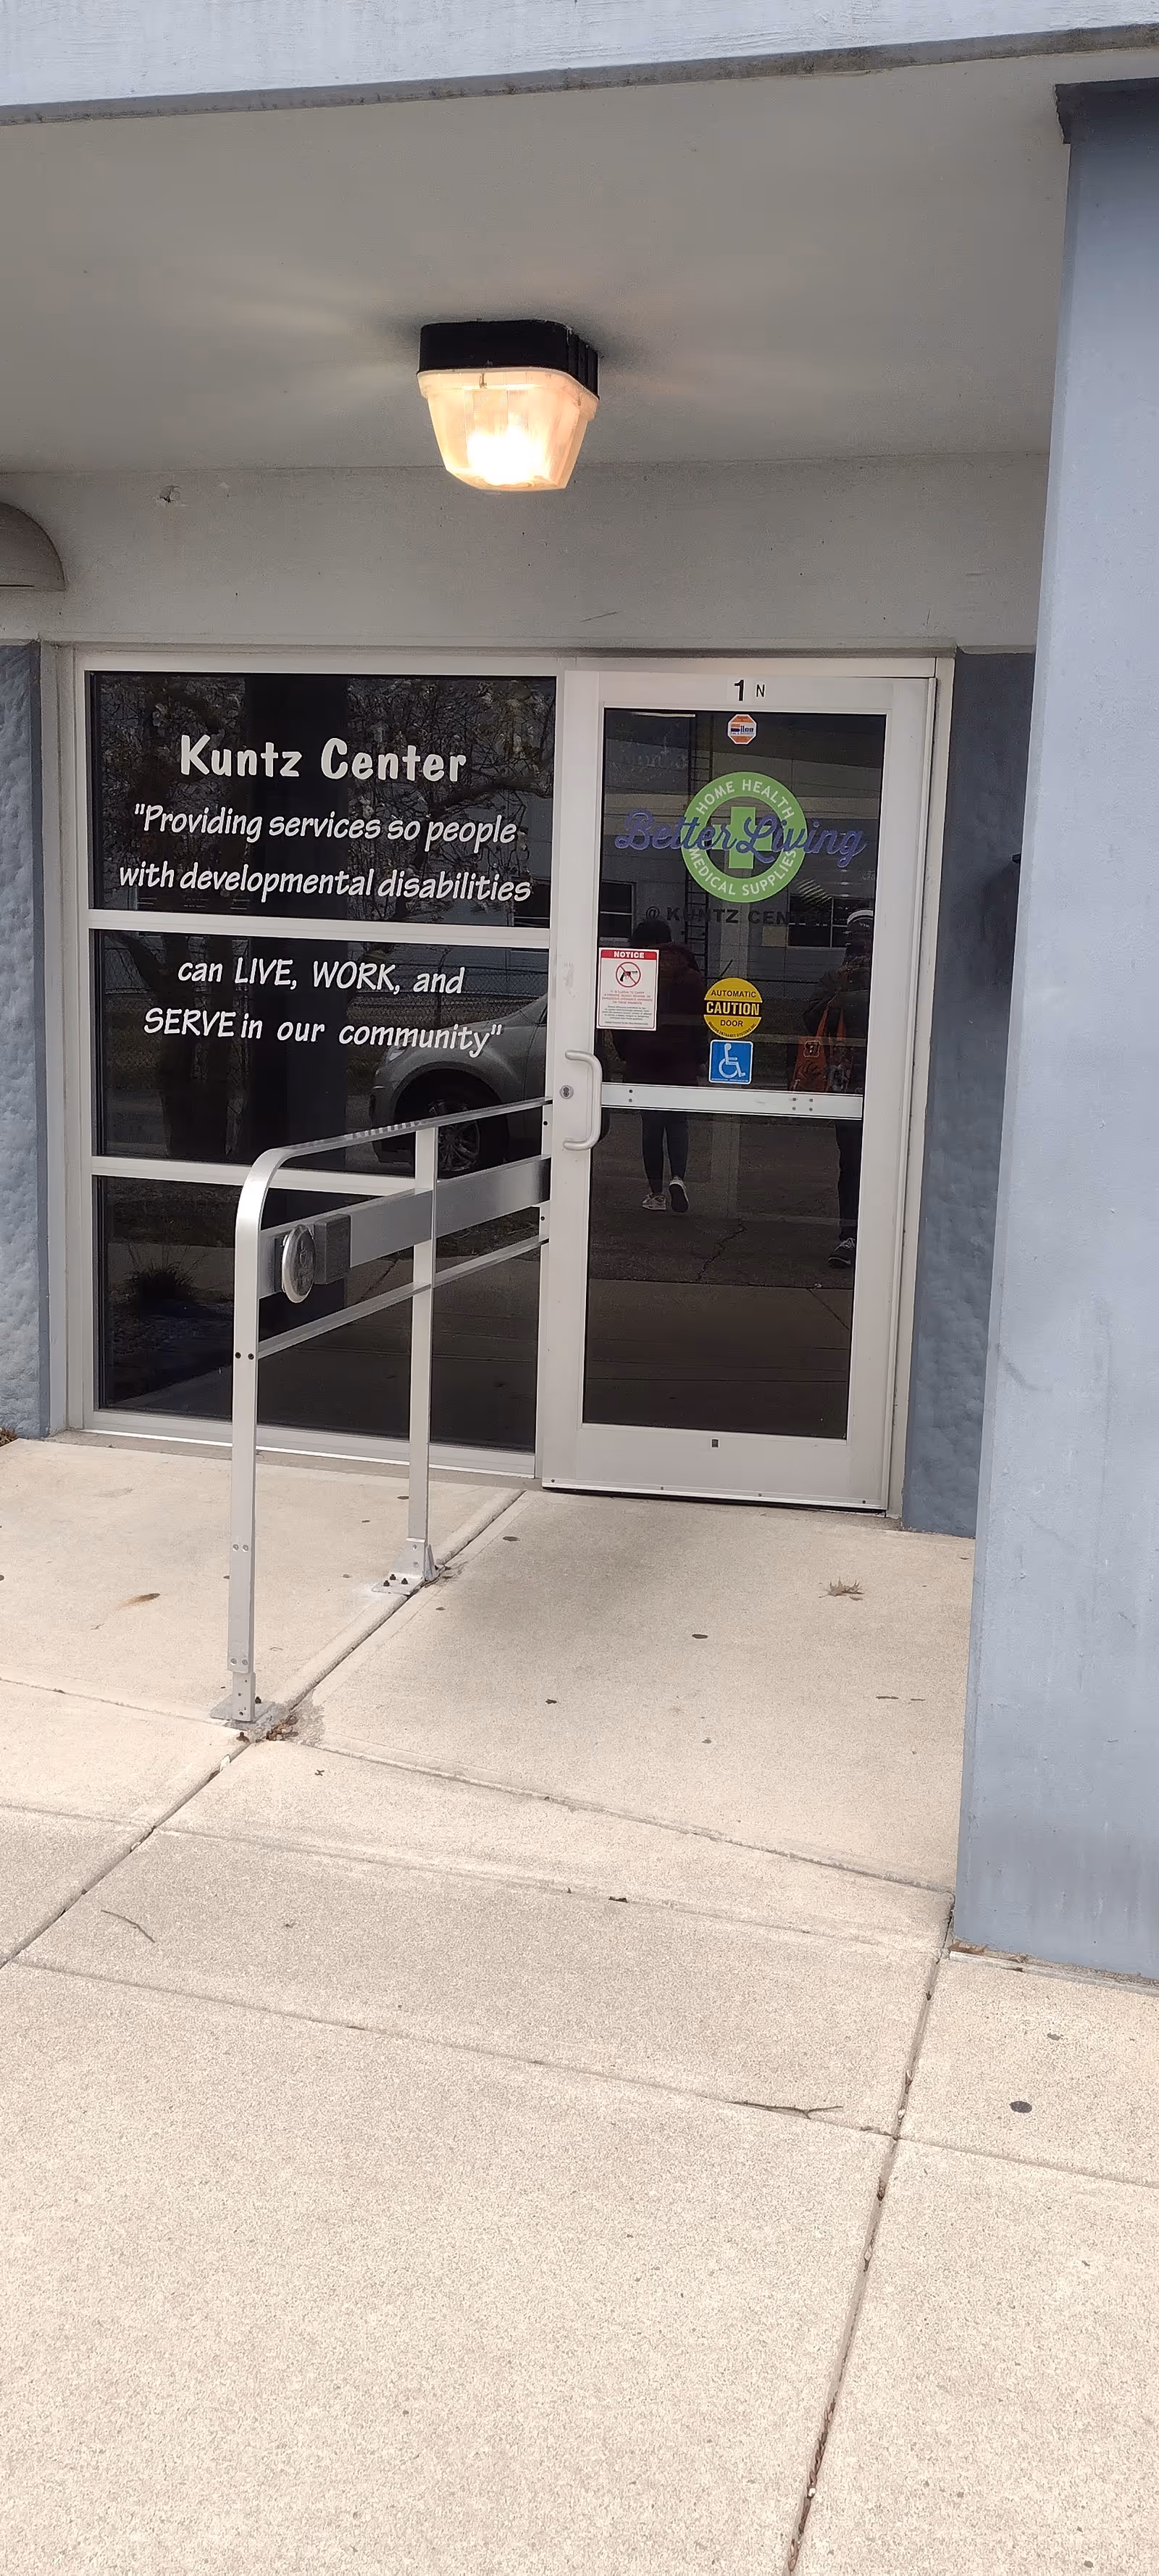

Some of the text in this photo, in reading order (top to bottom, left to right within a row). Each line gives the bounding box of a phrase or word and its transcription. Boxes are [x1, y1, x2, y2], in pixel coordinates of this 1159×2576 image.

[734, 679, 766, 702] 1 N
[180, 734, 466, 782] Kuntz Center
[696, 779, 795, 821] HOME HEALTH
[135, 803, 517, 854] "Providing services so people
[614, 808, 868, 868] Better Living
[120, 860, 531, 903] with developmental disabilities
[688, 846, 796, 896] MEDICAL SUPPLIES
[177, 956, 465, 995] can LIVE, WORK, and
[711, 989, 757, 998] AUTOMATIC
[706, 1001, 760, 1016] CAUTION
[143, 1007, 503, 1058] SERVE in our community"
